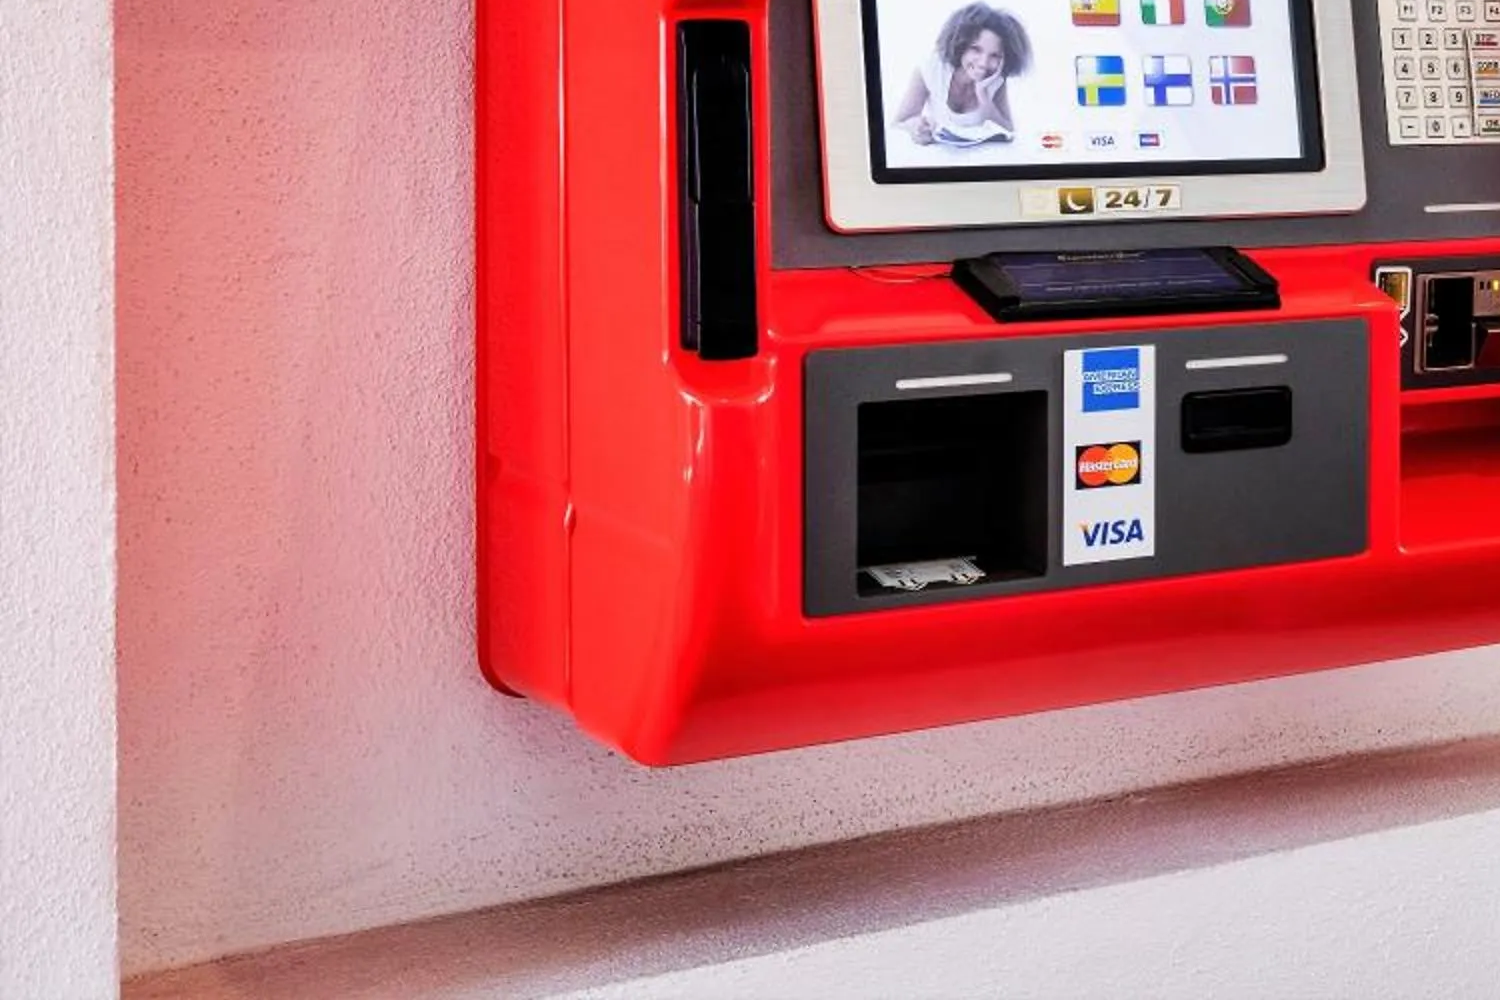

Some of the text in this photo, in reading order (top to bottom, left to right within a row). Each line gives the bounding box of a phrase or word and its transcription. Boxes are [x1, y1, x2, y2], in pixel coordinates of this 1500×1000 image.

[1431, 5, 1443, 15] F2
[1090, 134, 1115, 147] VISA
[1105, 187, 1173, 209] 24/7
[1080, 518, 1145, 547] VISA
